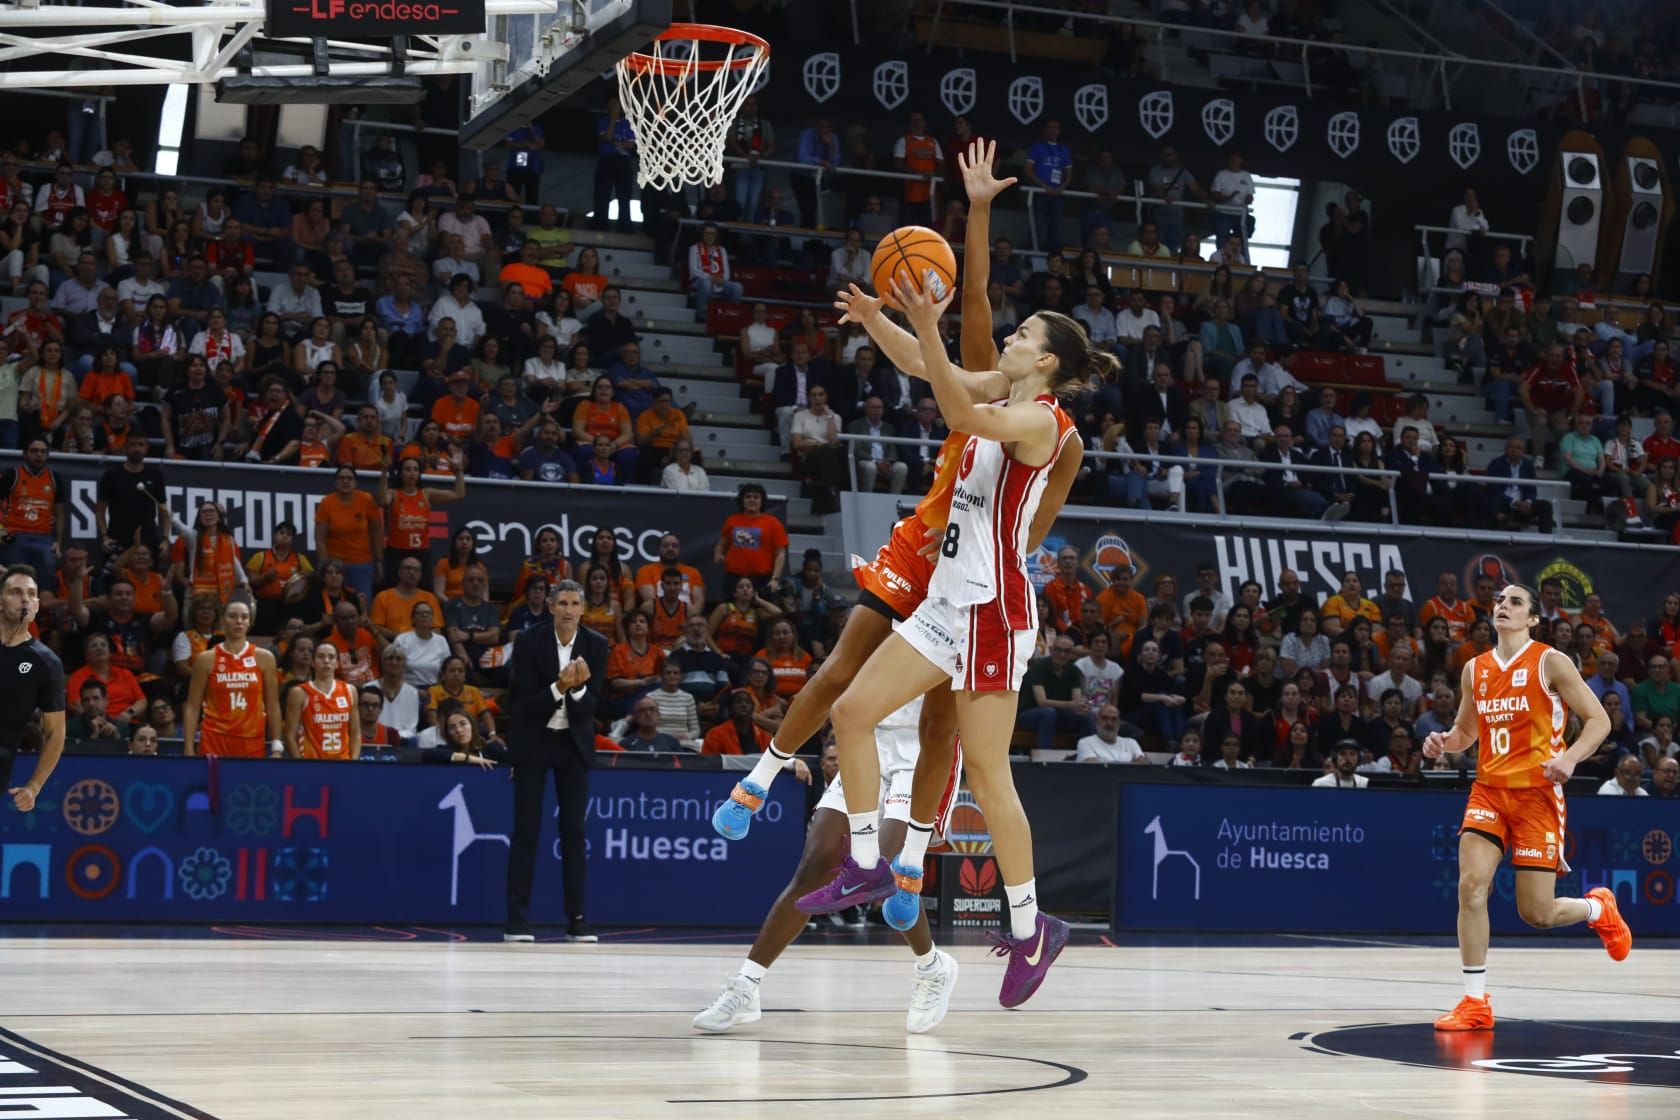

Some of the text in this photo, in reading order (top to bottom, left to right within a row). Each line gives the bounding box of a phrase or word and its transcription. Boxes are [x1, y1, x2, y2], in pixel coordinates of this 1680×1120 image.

[311, 0, 440, 20] LF endesa
[882, 566, 913, 593] PULEVA
[1214, 535, 1413, 609] HUESCA
[216, 672, 259, 683] VALENCIA
[229, 691, 248, 711] 14
[1476, 695, 1530, 715] VALENCIA
[1485, 713, 1515, 724] BASKET
[322, 732, 343, 751] 25
[1489, 727, 1511, 755] 10
[1216, 816, 1365, 846] Ayuntamiento
[604, 827, 728, 861] Huesca
[1216, 846, 1330, 870] de Huesca
[953, 898, 1001, 912] SUPERCOPA
